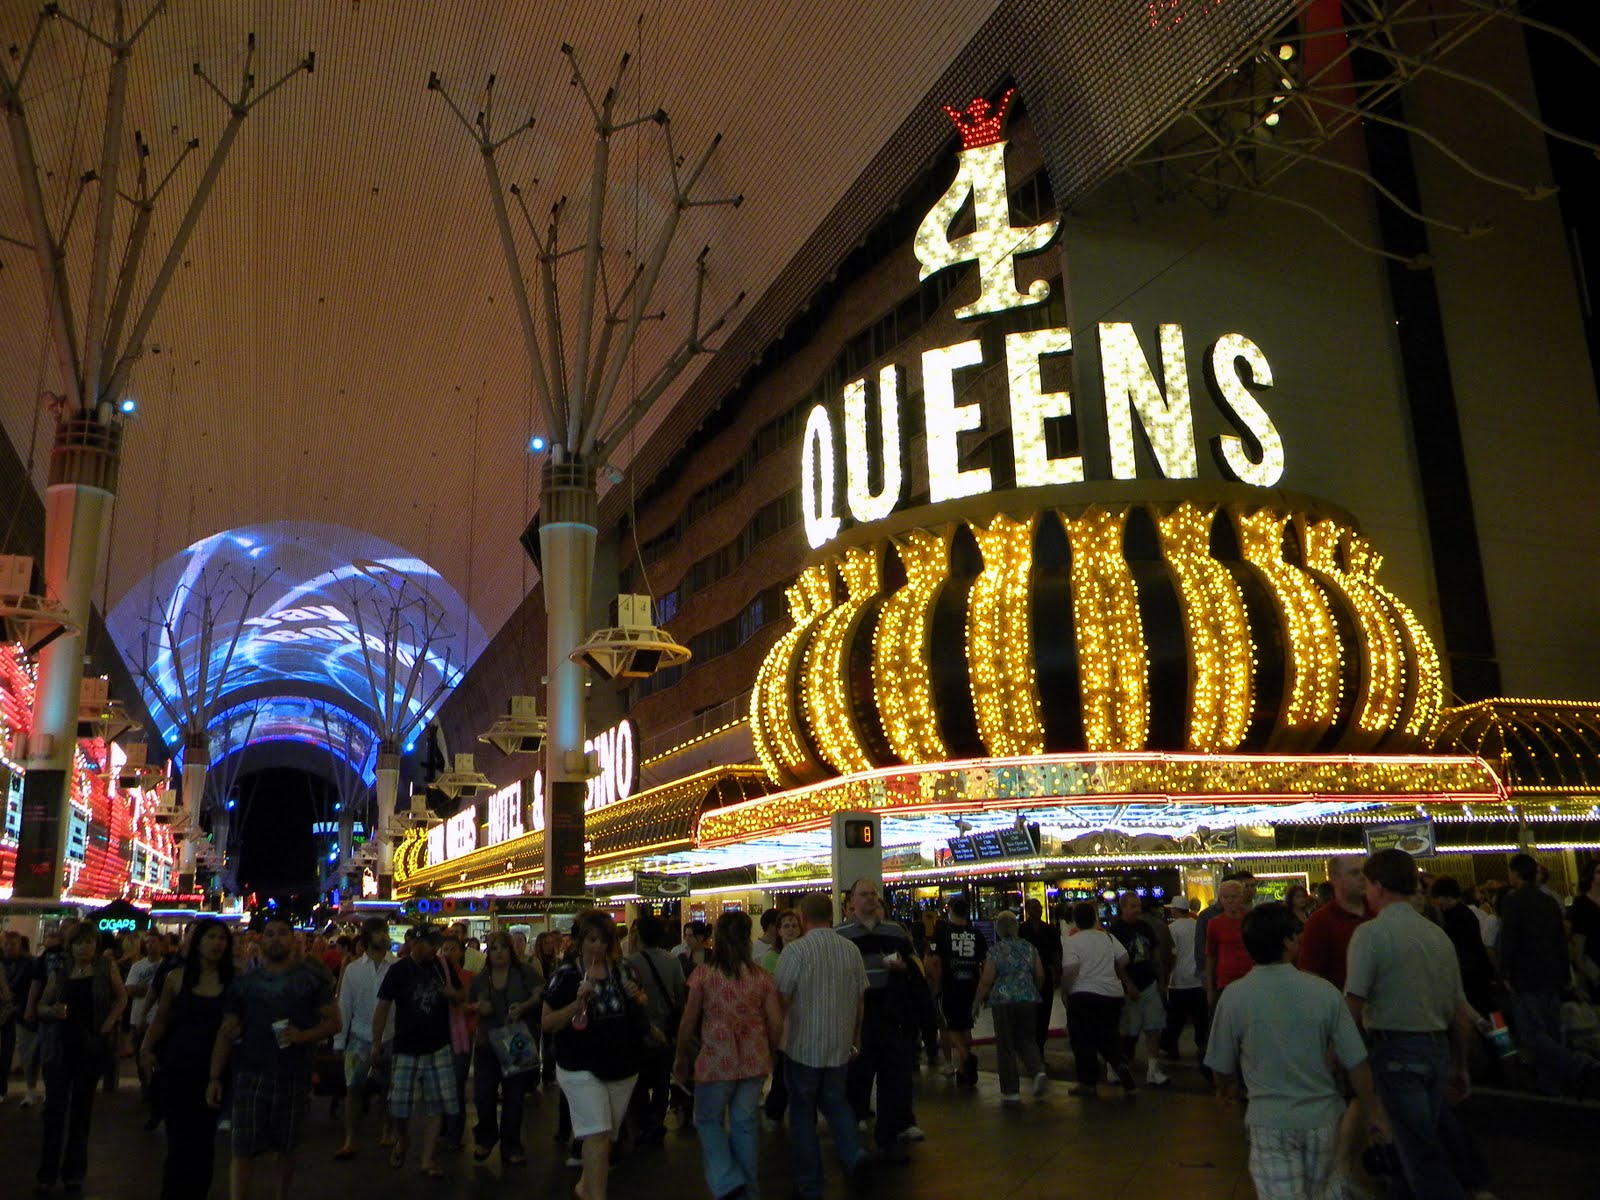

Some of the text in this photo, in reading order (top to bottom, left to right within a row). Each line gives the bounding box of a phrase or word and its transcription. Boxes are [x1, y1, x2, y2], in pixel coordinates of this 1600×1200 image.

[913, 141, 1061, 319] 4
[801, 322, 1285, 549] QUEENS
[488, 780, 524, 846] HOTEL
[863, 827, 871, 843] 8
[507, 901, 532, 910] Gelato
[99, 919, 136, 931] CIGARS
[952, 940, 975, 956] 43
